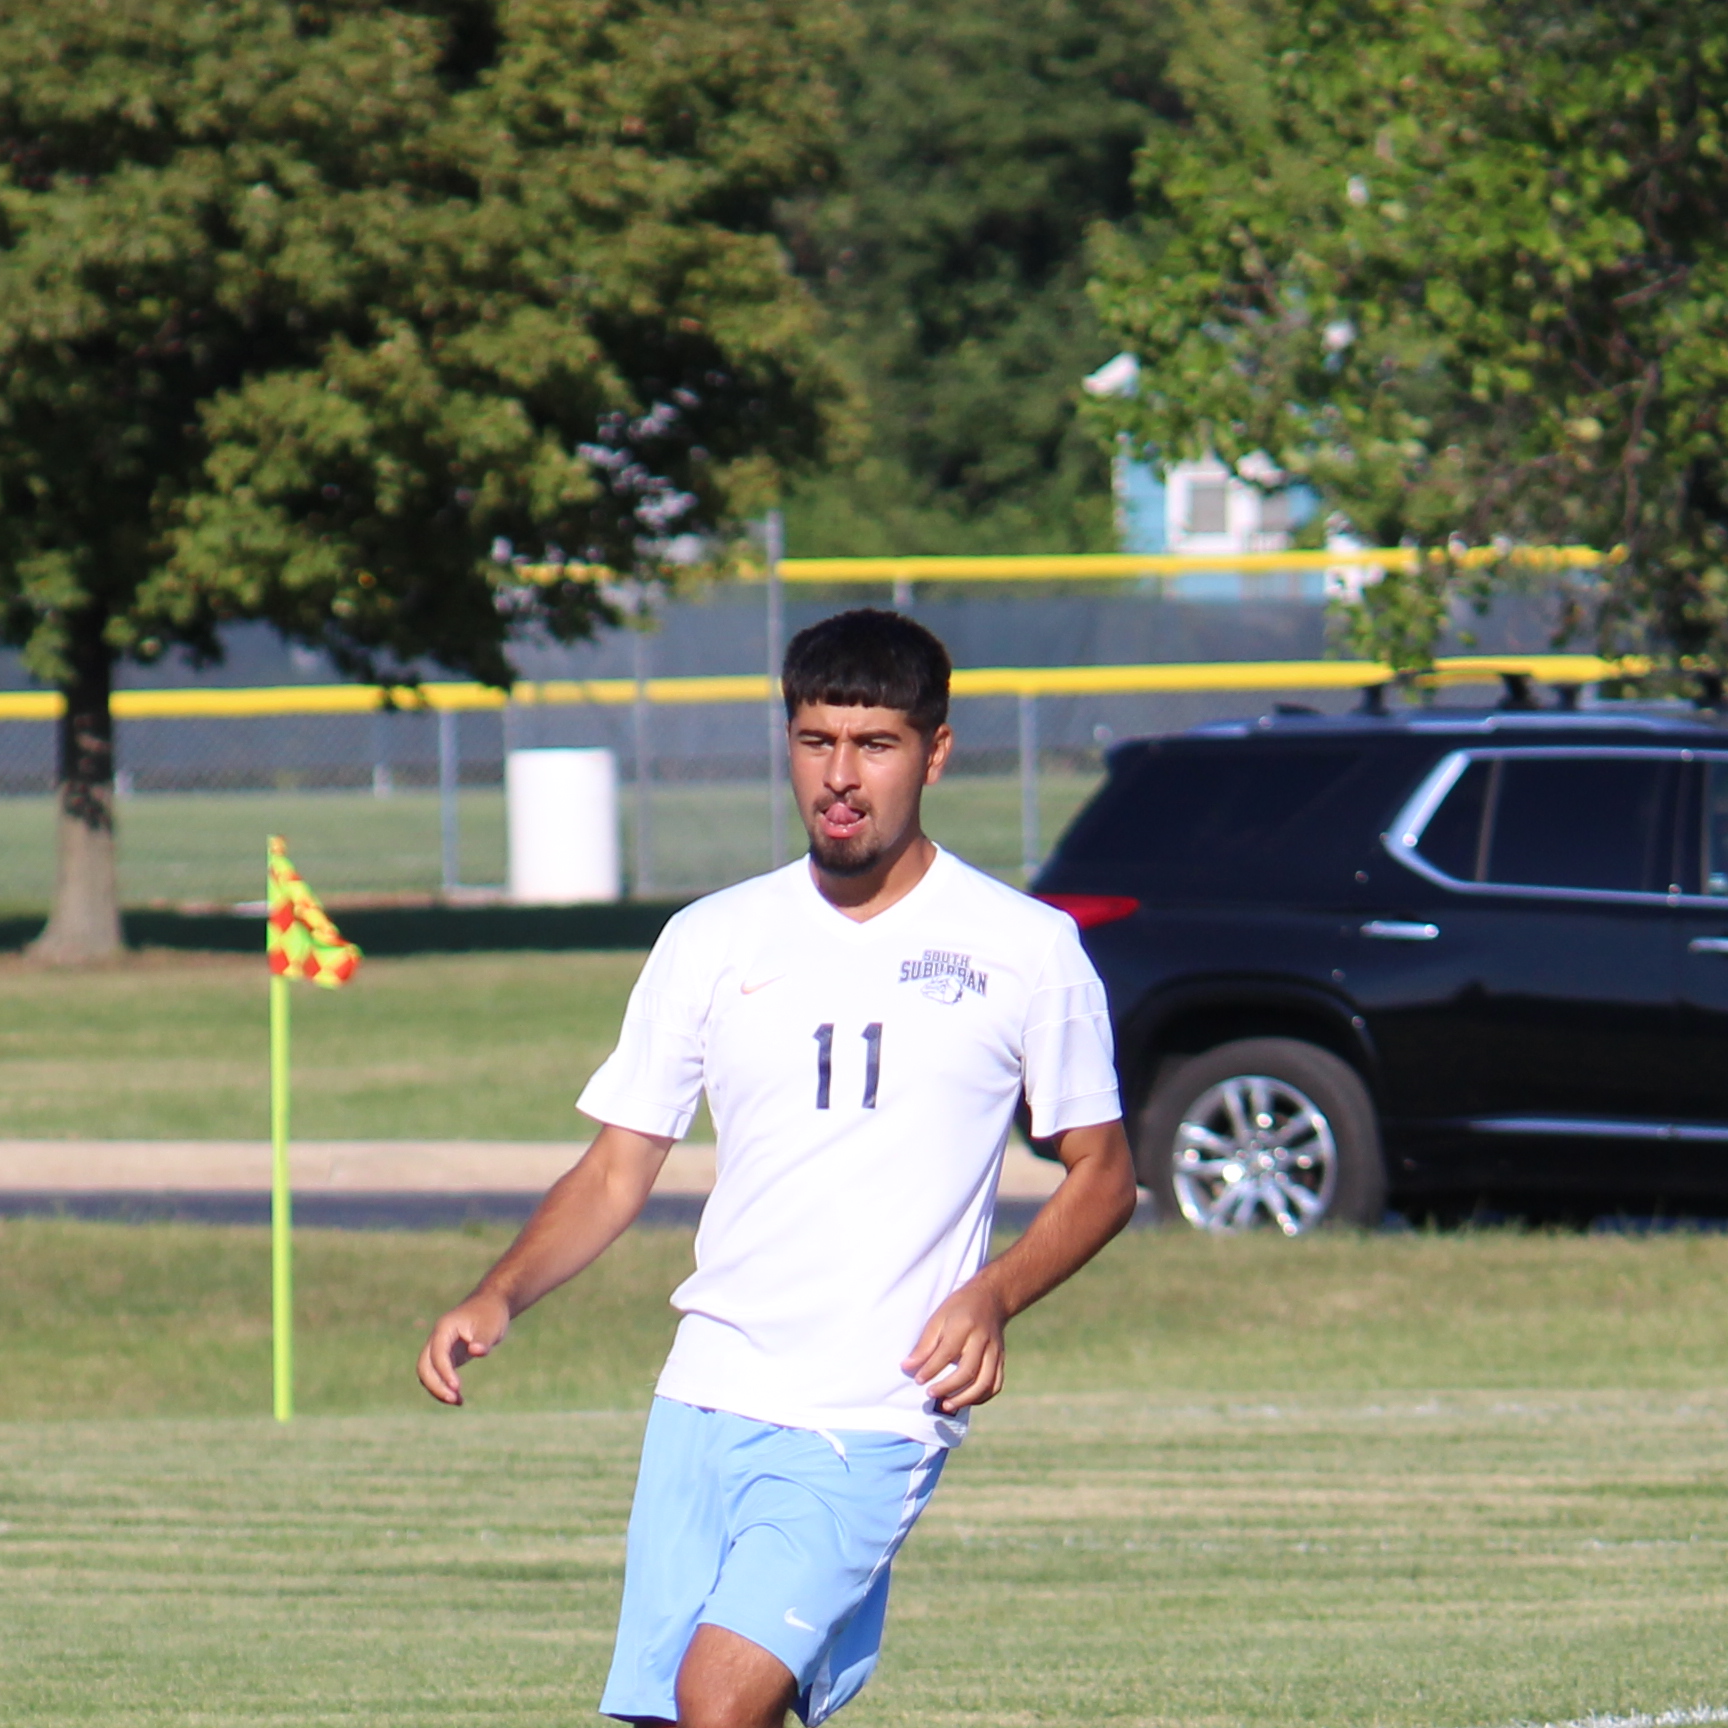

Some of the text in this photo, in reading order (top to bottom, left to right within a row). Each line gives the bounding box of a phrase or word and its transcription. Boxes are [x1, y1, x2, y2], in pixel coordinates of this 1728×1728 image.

[922, 949, 971, 968] SOUTH
[899, 959, 989, 997] SUBURBAN
[812, 1022, 883, 1110] 11
